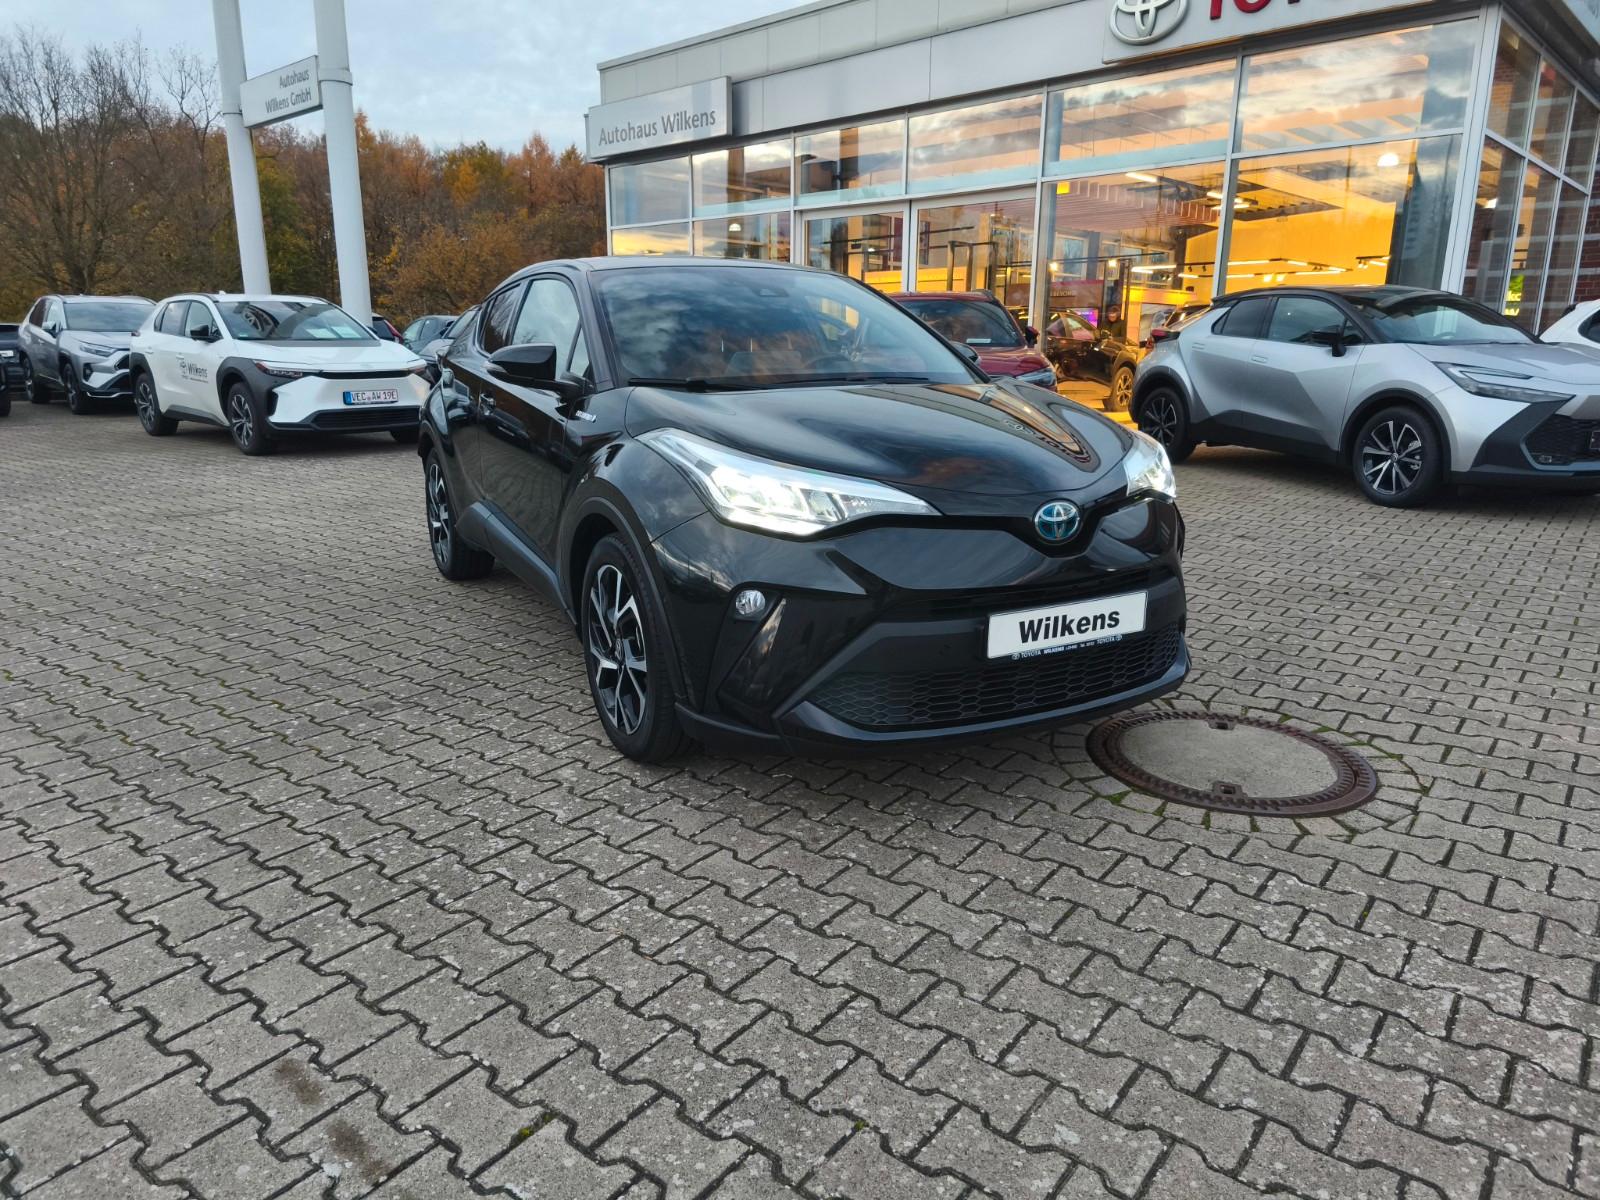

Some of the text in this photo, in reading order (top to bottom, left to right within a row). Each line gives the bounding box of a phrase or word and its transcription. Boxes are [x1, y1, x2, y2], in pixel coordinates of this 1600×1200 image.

[279, 69, 310, 88] Autohaus
[265, 88, 312, 114] Wilkens GmbH
[598, 110, 716, 146] Autohaus Wilkens
[351, 392, 367, 402] VEC
[1018, 610, 1121, 644] Wilkens
[1021, 649, 1042, 659] TOYOTA
